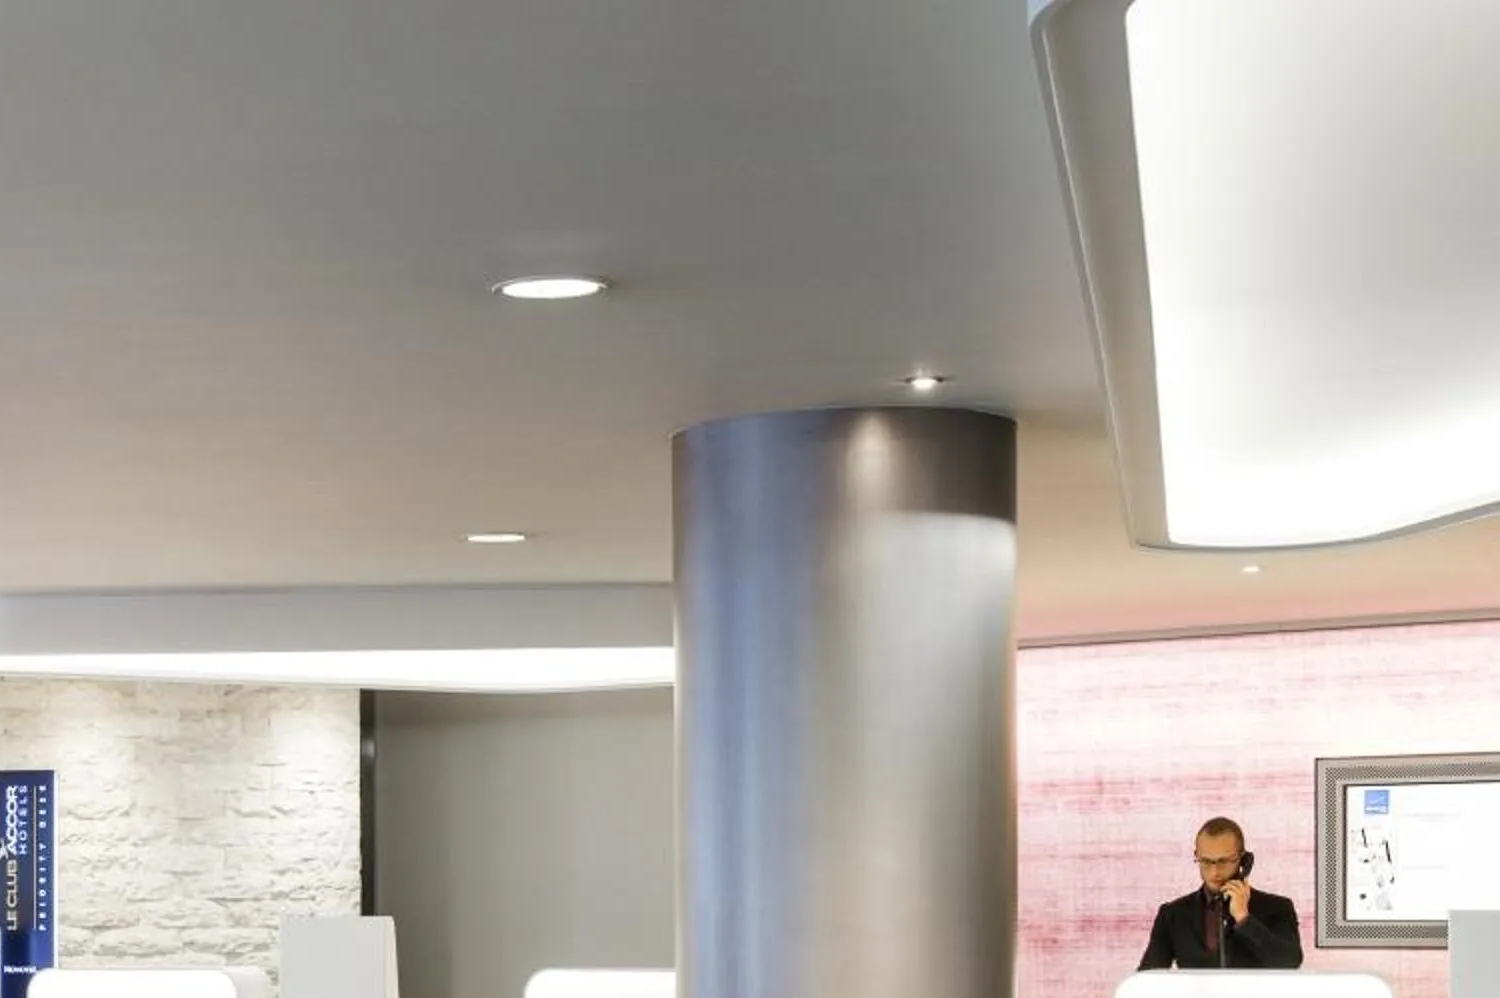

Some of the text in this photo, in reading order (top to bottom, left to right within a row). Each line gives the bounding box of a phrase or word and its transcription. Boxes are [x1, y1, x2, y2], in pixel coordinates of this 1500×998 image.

[5, 785, 19, 931] LE CLUB ACCOR
[18, 785, 29, 855] HOTELS
